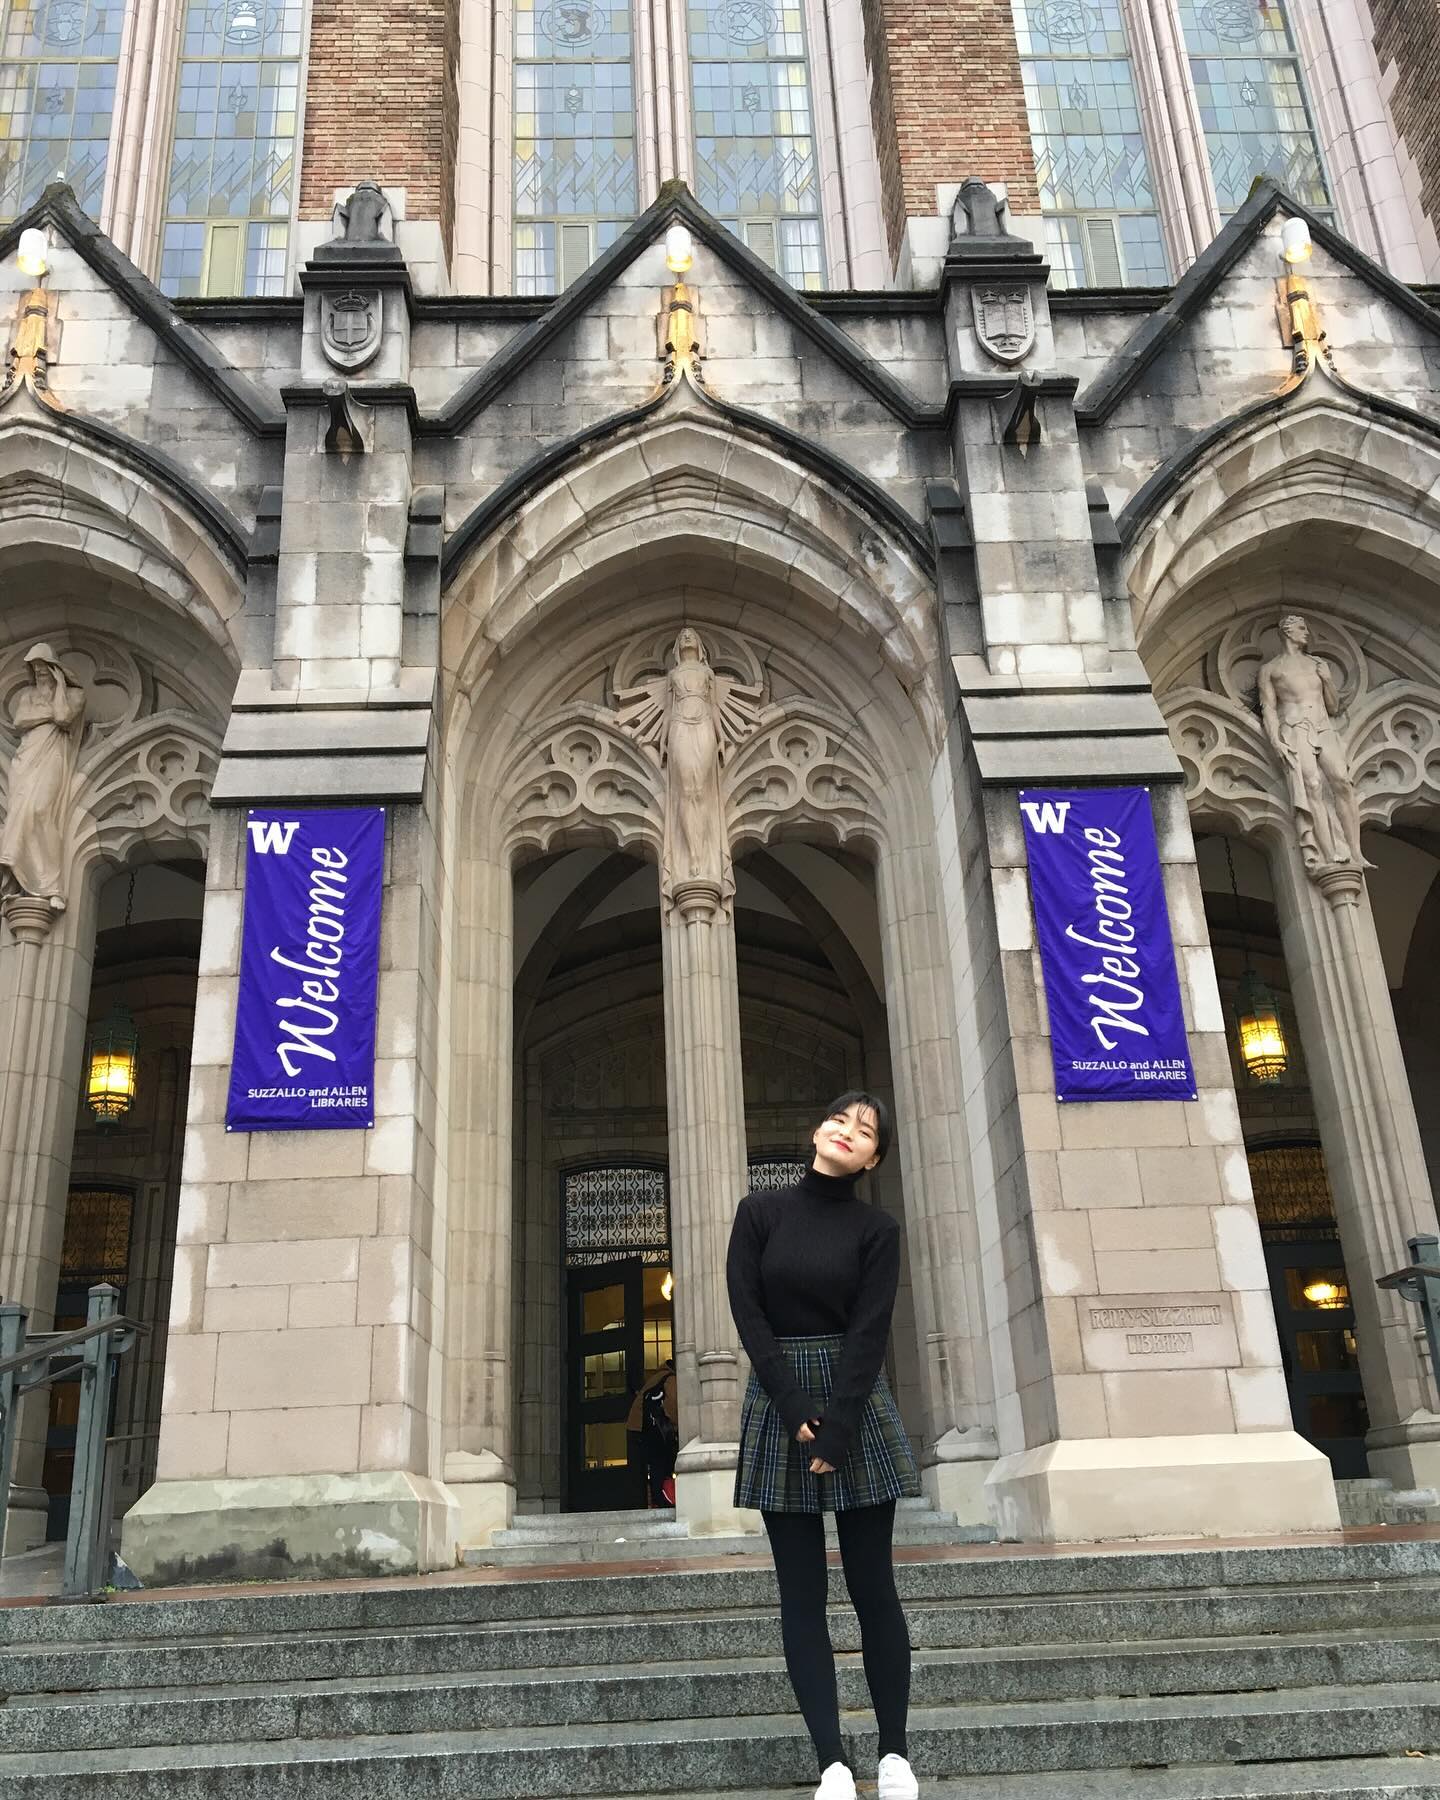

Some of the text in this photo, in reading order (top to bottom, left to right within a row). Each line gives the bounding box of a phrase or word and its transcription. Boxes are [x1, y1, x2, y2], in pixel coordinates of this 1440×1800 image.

[1019, 802, 1070, 836] W
[247, 821, 299, 854] W
[1066, 827, 1149, 1050] Welcome
[271, 846, 348, 1077] Welcome
[1072, 1059, 1186, 1071] SUZZALLO and ALLEN
[1134, 1070, 1187, 1080] LIBRARIES
[247, 1086, 367, 1099] SUZZALLO and ALLEN
[311, 1097, 368, 1108] LIBRARIES
